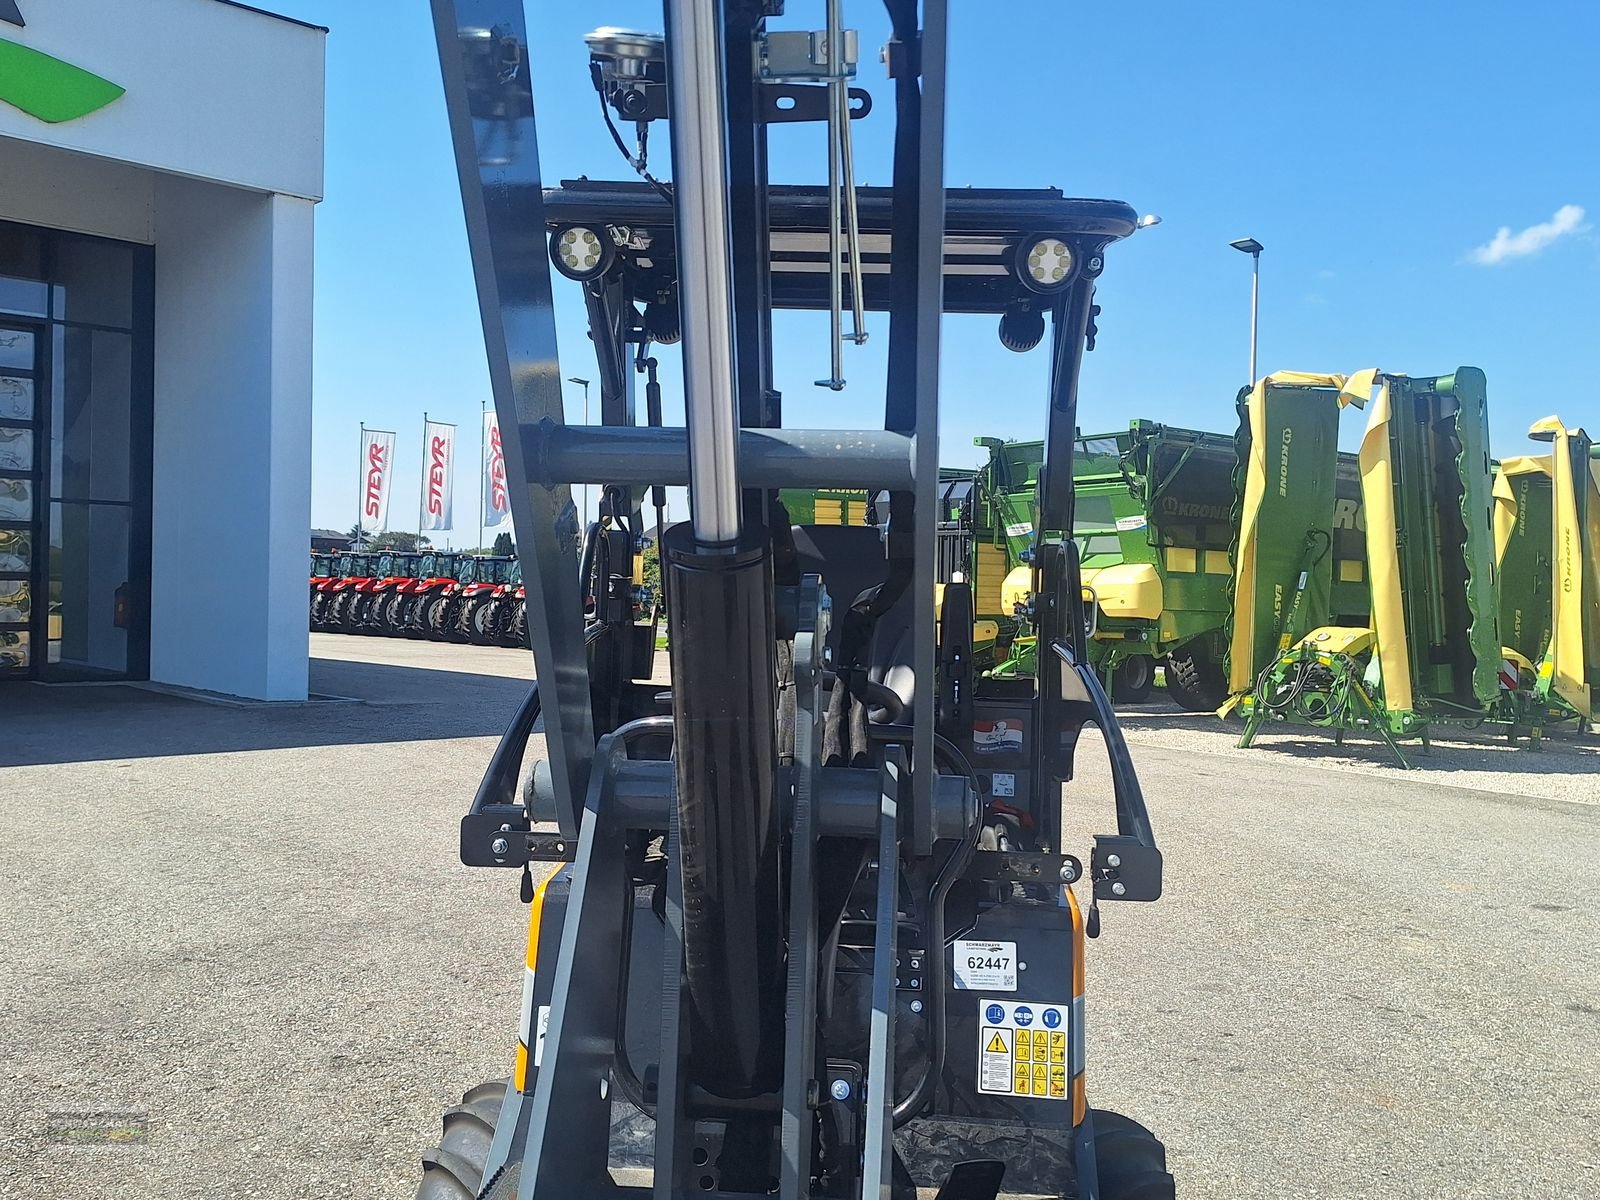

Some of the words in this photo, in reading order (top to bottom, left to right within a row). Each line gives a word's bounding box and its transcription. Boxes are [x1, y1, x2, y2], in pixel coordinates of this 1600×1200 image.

[366, 443, 384, 519] STEYR
[428, 436, 445, 517] STEYR
[490, 426, 507, 513] STEYR
[1280, 444, 1288, 497] KRONE
[1519, 495, 1528, 537] KRONE
[968, 957, 1010, 970] 62447
